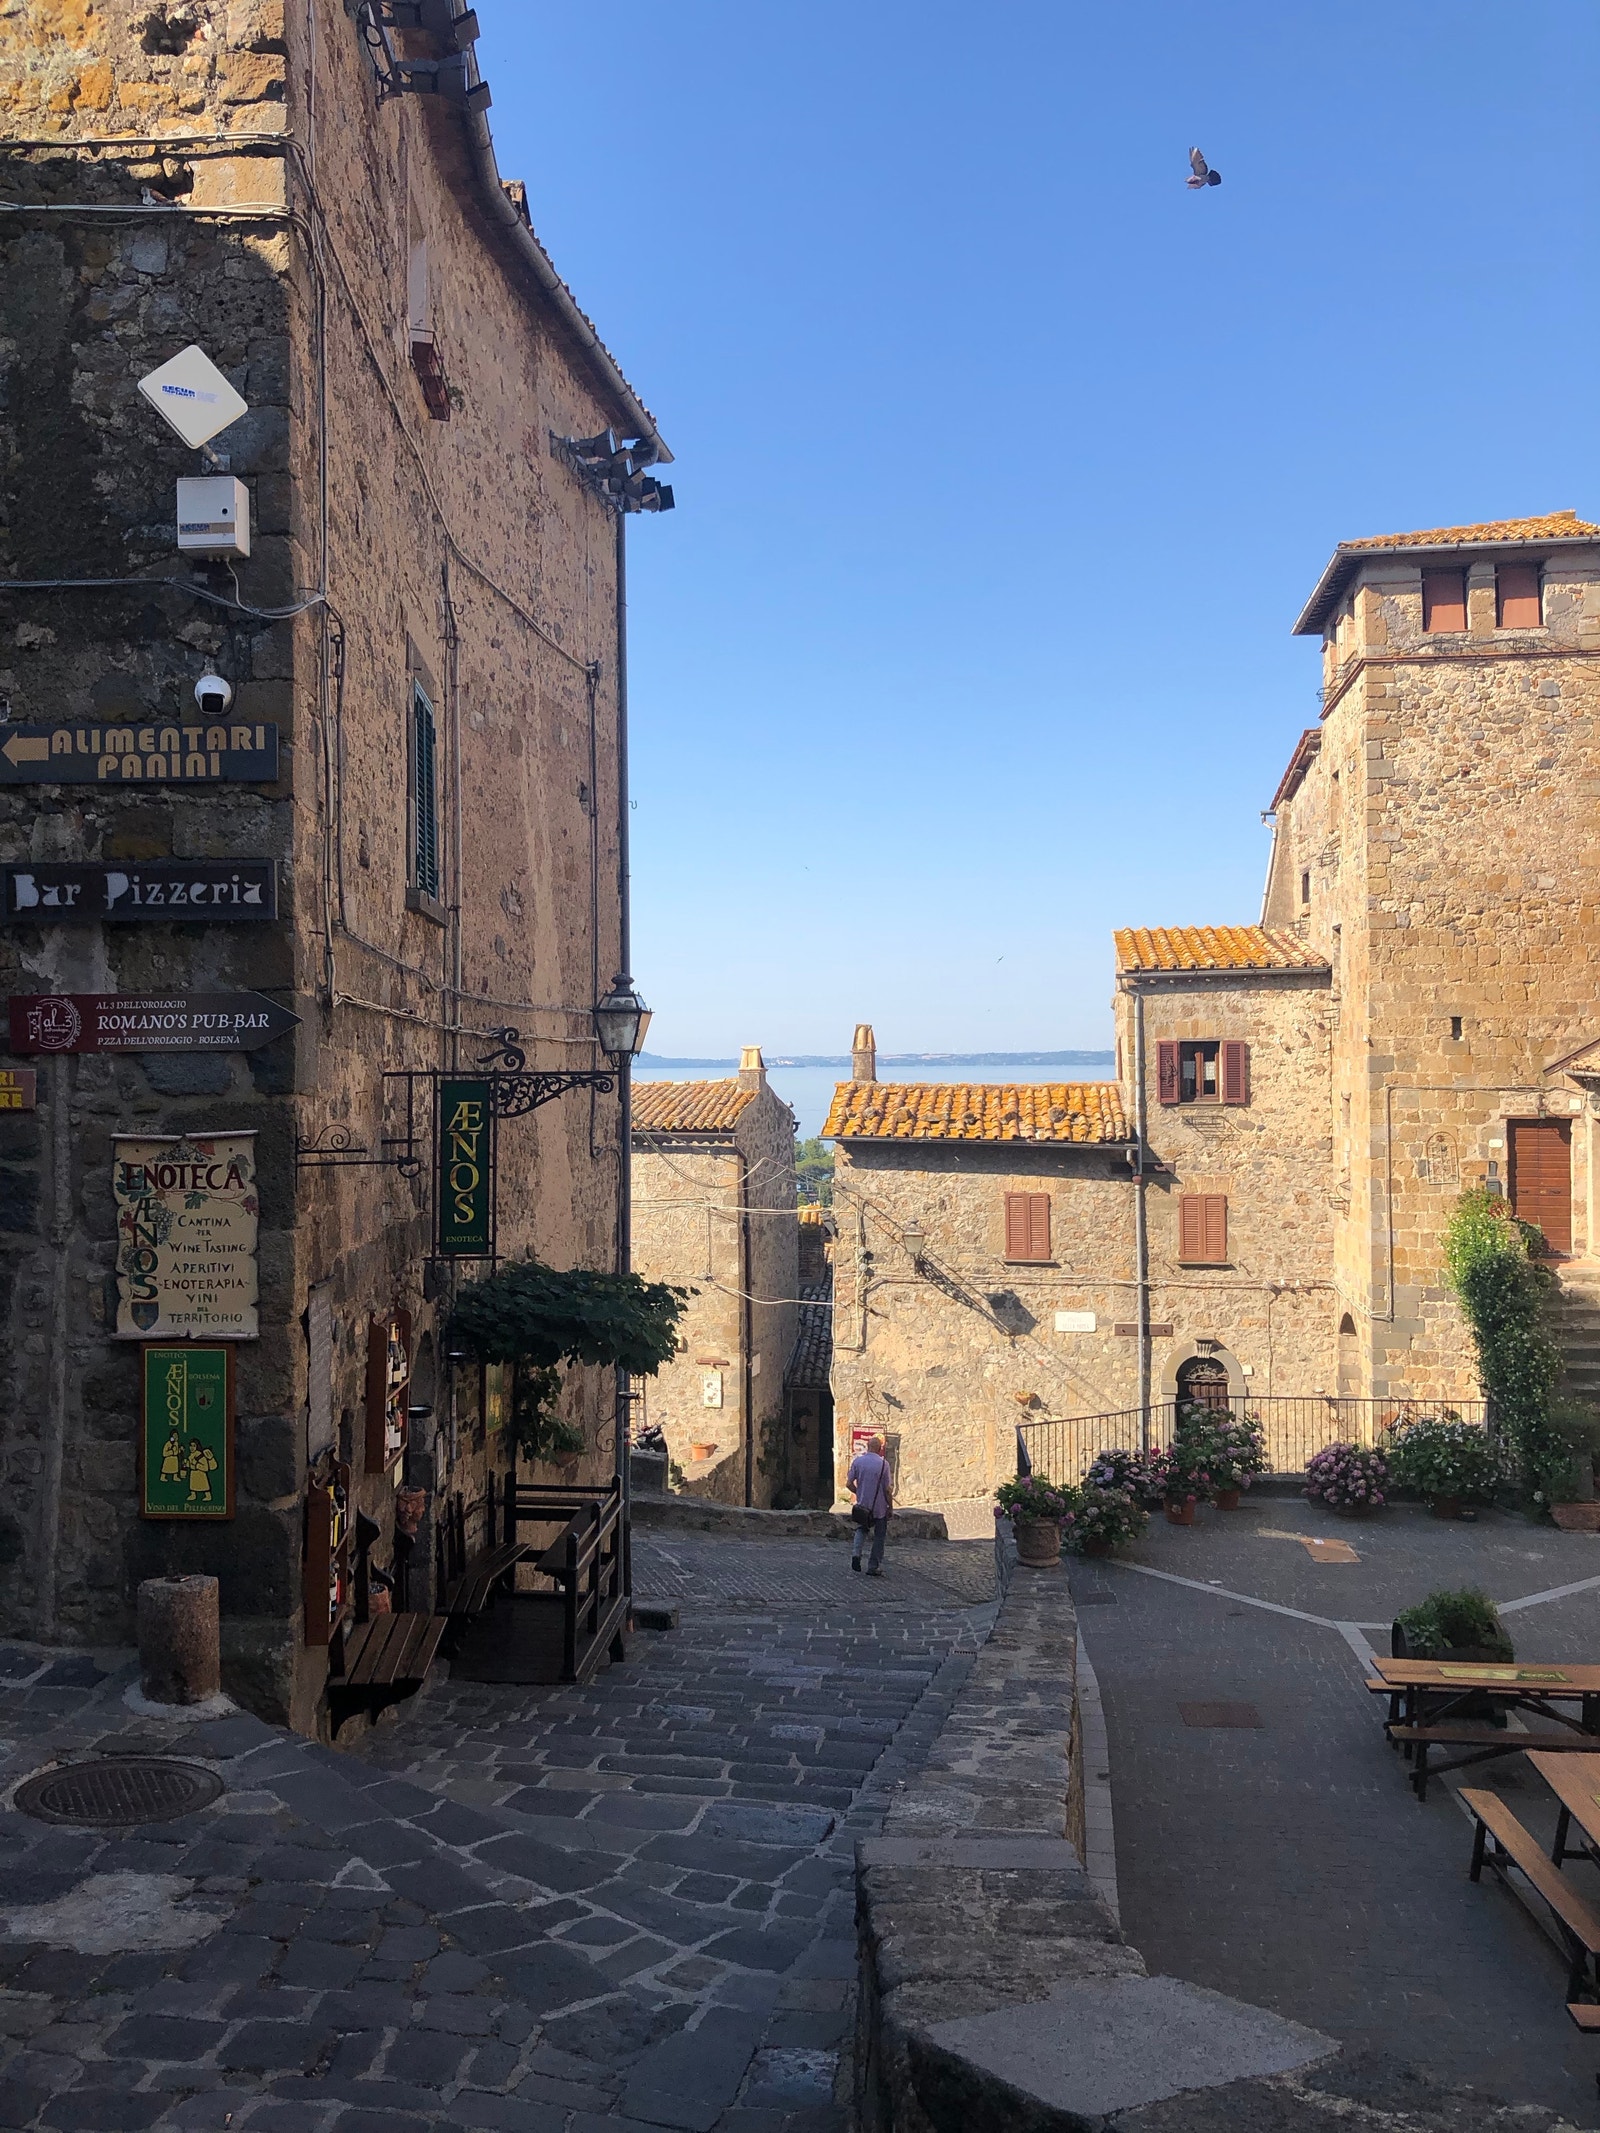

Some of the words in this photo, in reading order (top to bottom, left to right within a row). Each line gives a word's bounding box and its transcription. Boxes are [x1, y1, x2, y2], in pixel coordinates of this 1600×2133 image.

[162, 385, 196, 395] SECUR
[51, 725, 265, 754] ALIMENTARI
[97, 752, 220, 779] PANINI
[13, 874, 81, 911] Bar
[103, 872, 262, 910] Pizzeria
[96, 1001, 108, 1010] AL
[109, 1001, 115, 1010] 3
[116, 1000, 187, 1010] DELL'OROLOGIO
[97, 1014, 188, 1030] ROMANO'S
[192, 1013, 270, 1029] PUB-BAR
[123, 1036, 193, 1045] DELL'OROLOGIO
[199, 1035, 240, 1044] BOLSENA
[126, 1163, 245, 1190] ENOTECA
[178, 1215, 231, 1227] CANTINA
[446, 1235, 484, 1243] ENOTECA
[168, 1242, 201, 1253] WINE
[202, 1239, 247, 1253] TASTING
[170, 1262, 235, 1274] APERITIVI
[186, 1294, 218, 1303] VINI
[168, 1313, 243, 1324] TERRITORIO
